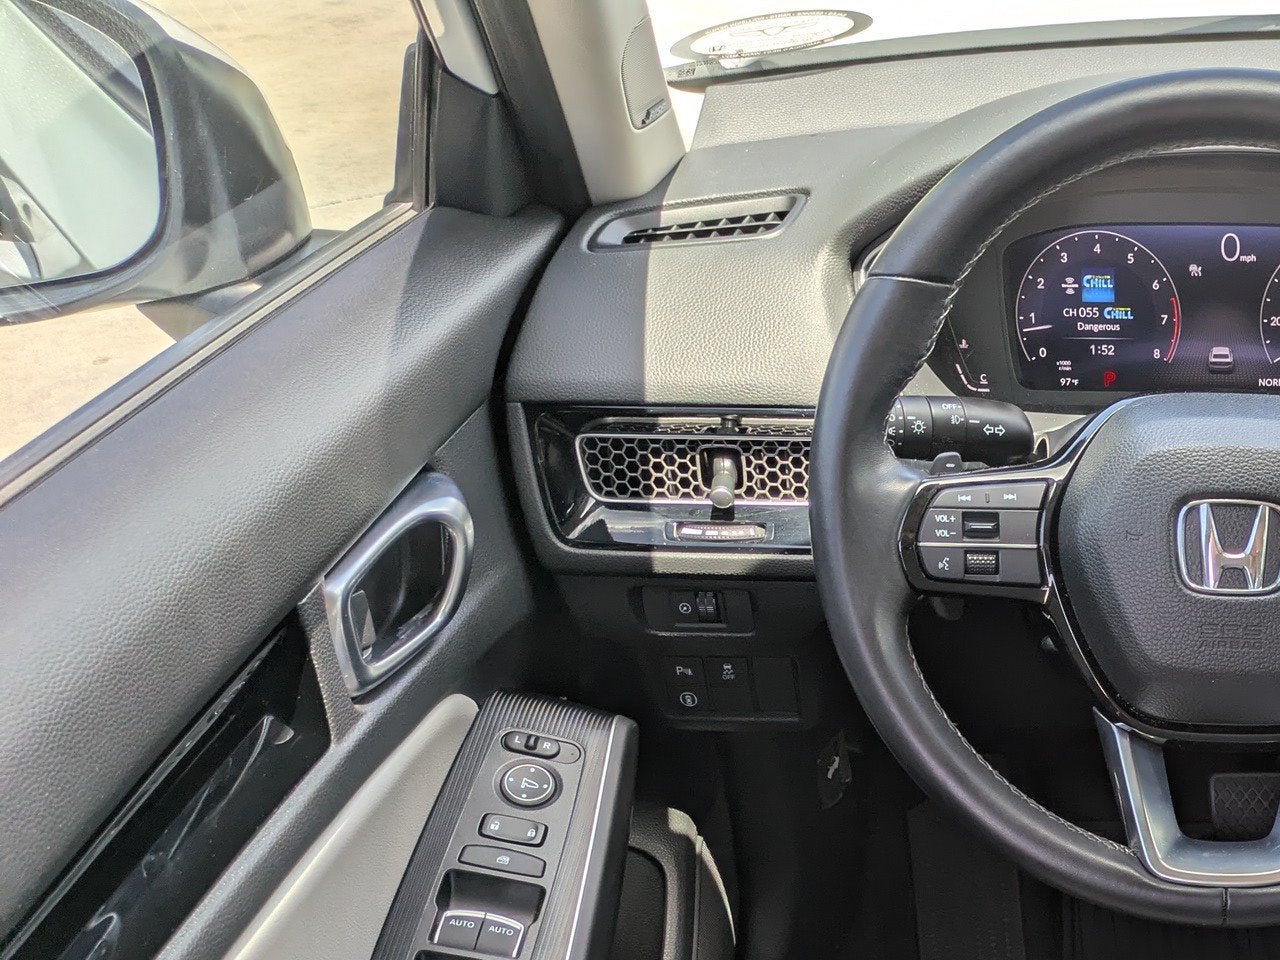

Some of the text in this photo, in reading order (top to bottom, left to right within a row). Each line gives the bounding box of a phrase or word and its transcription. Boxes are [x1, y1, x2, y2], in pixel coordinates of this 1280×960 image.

[1094, 244, 1101, 254] 4
[1221, 233, 1256, 263] 0 mph
[1060, 253, 1068, 262] 3
[1127, 254, 1134, 264] 5
[1037, 279, 1044, 288] 2
[1083, 275, 1113, 288] CHILL
[1152, 280, 1159, 290] 6
[1063, 307, 1134, 319] CH 055 CHILL
[1029, 313, 1035, 324] 1
[1161, 315, 1168, 325] 7
[1077, 322, 1120, 332] Dangerous
[1039, 348, 1047, 358] 0
[1090, 345, 1115, 356] 1:52
[1153, 349, 1161, 359] 8
[980, 374, 987, 382] C
[449, 918, 475, 929] AUTO
[488, 925, 514, 936] AUTO
